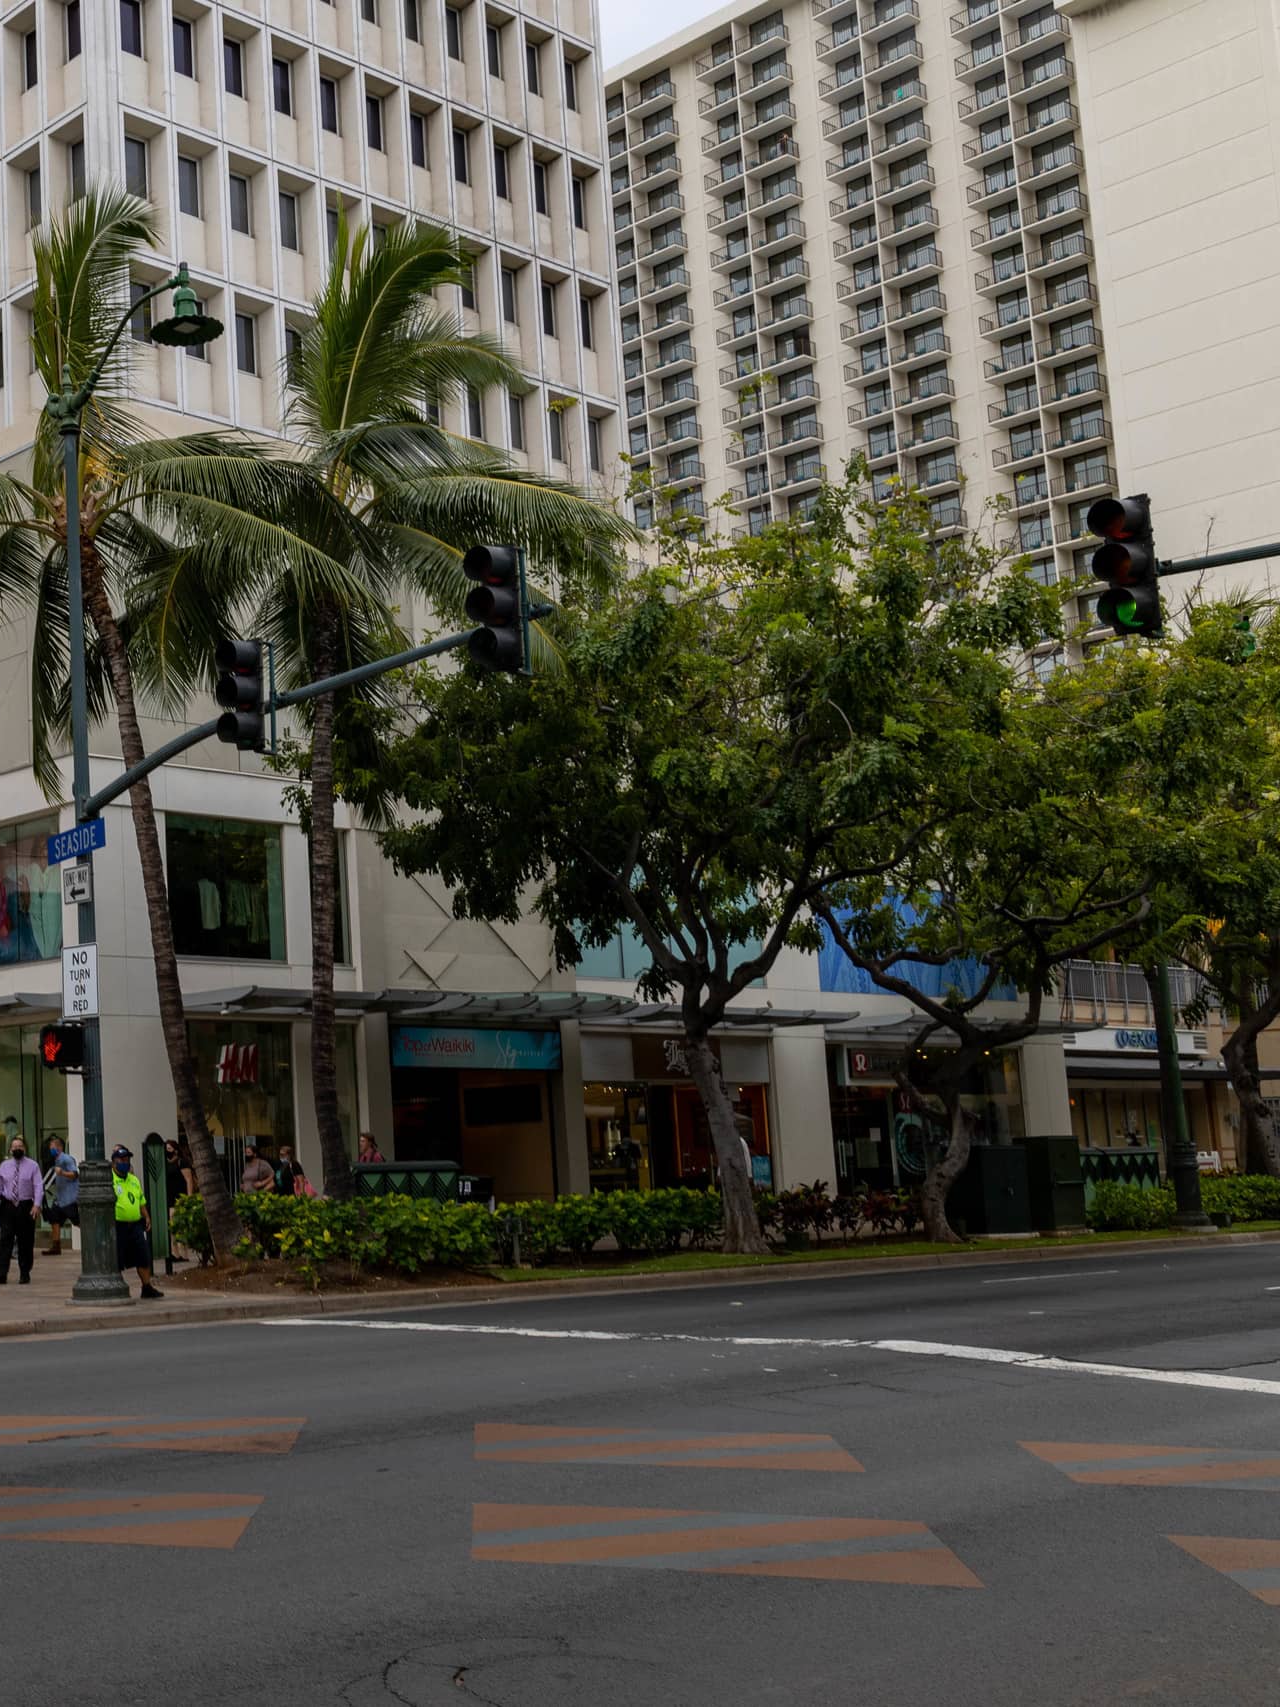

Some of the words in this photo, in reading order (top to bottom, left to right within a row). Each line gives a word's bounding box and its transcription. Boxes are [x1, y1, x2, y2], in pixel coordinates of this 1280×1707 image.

[55, 825, 97, 859] SEASIDE
[65, 872, 75, 887] ONE
[77, 869, 88, 883] WAY
[72, 951, 88, 966] NO
[70, 968, 91, 982] TURN
[74, 984, 86, 996] ON
[73, 999, 89, 1012] RED
[431, 1036, 476, 1054] Waikiki
